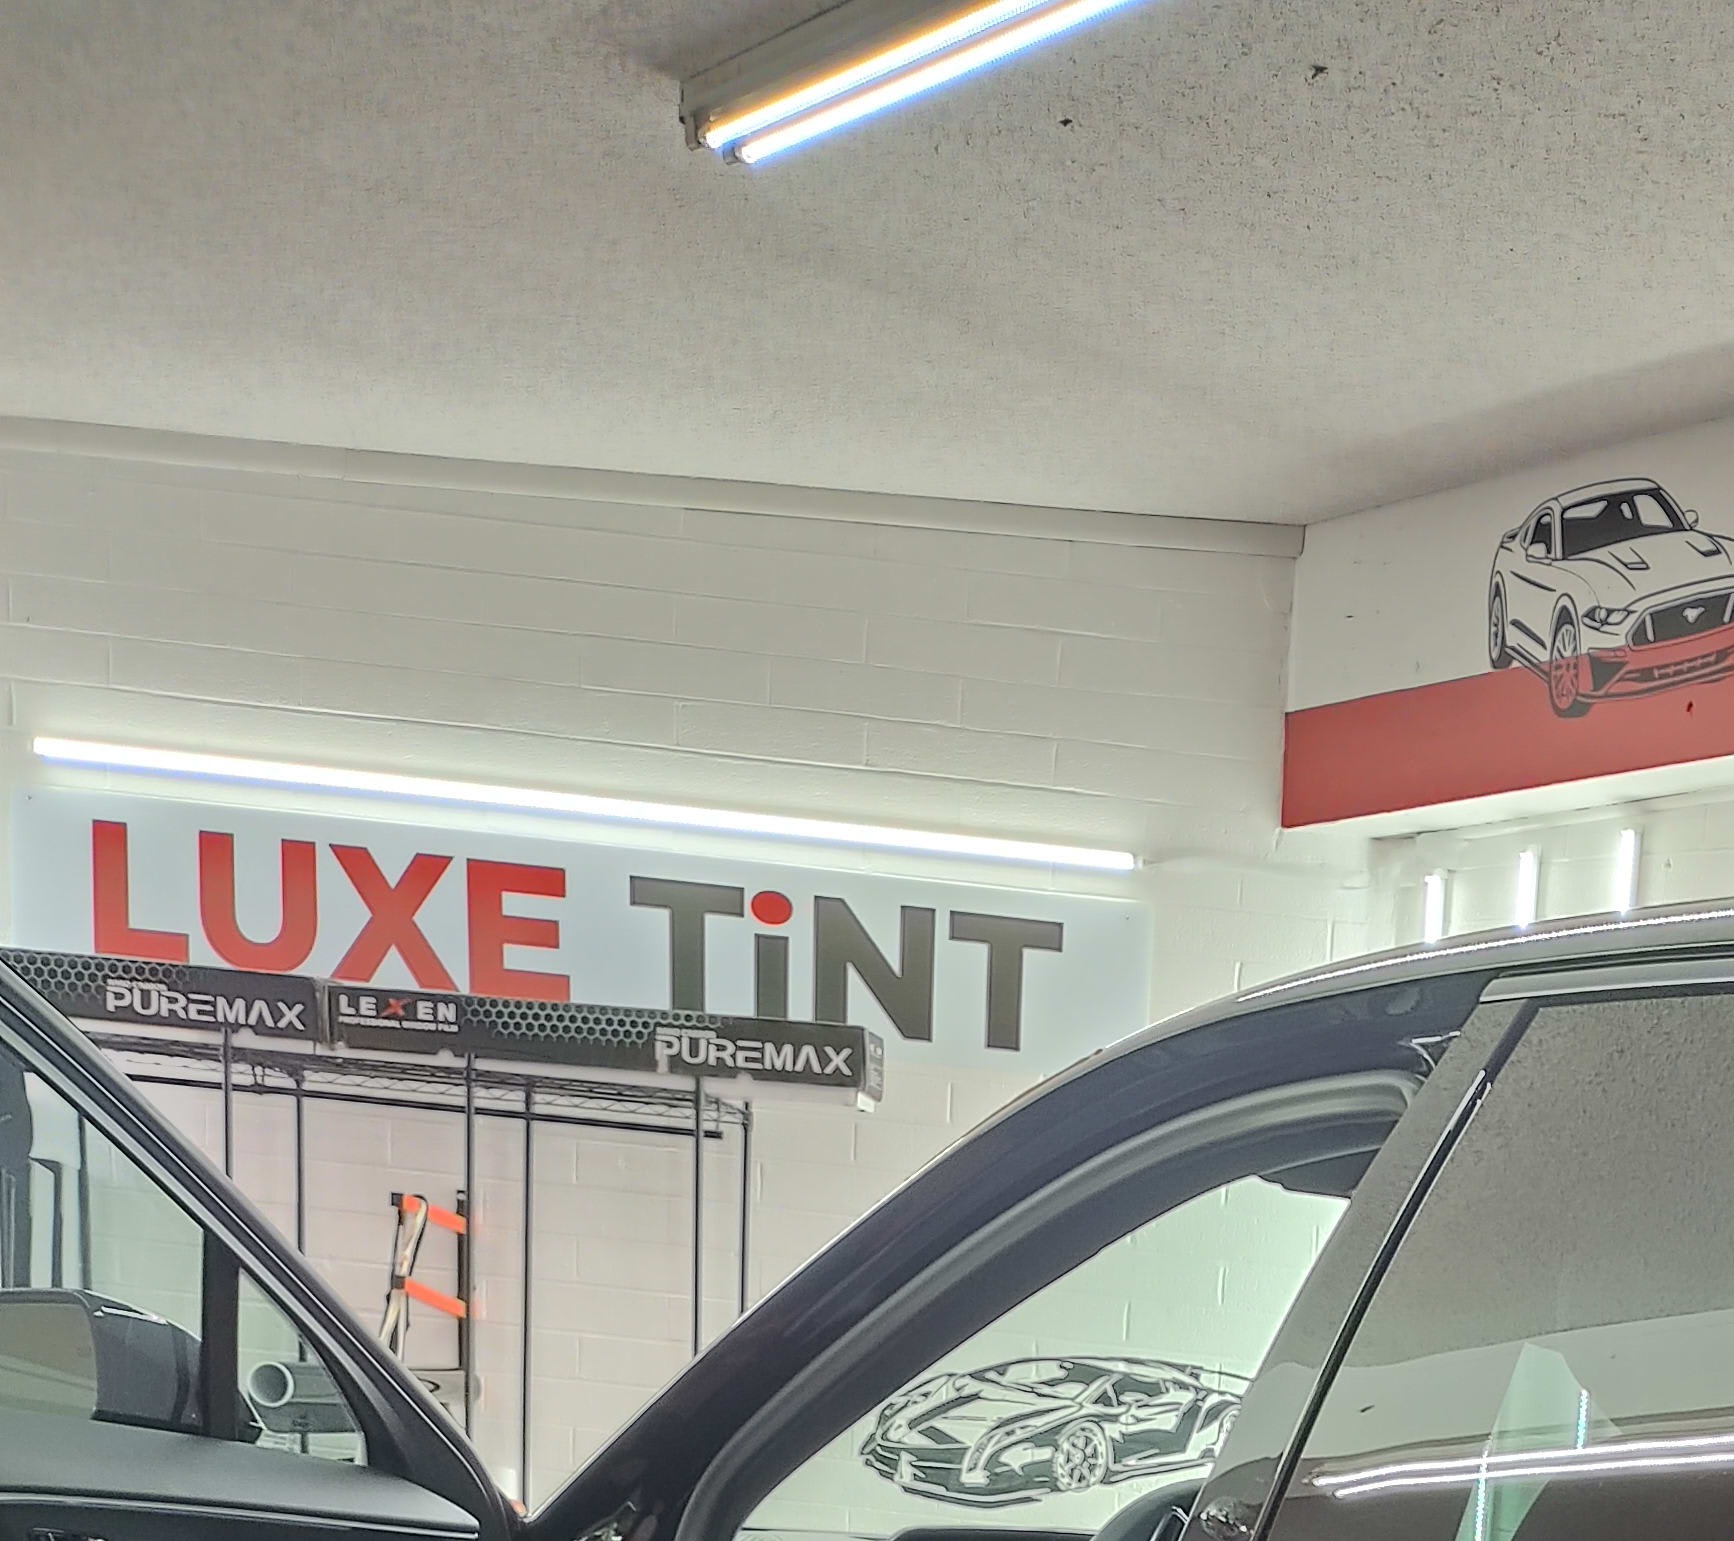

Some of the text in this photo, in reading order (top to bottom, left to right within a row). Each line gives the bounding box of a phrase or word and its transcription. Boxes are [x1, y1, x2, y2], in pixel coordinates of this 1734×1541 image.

[92, 819, 570, 1001] LUXE
[106, 984, 305, 1031] PUREMAX
[338, 993, 457, 1023] LEXEN
[655, 1034, 853, 1077] PUREMAX
